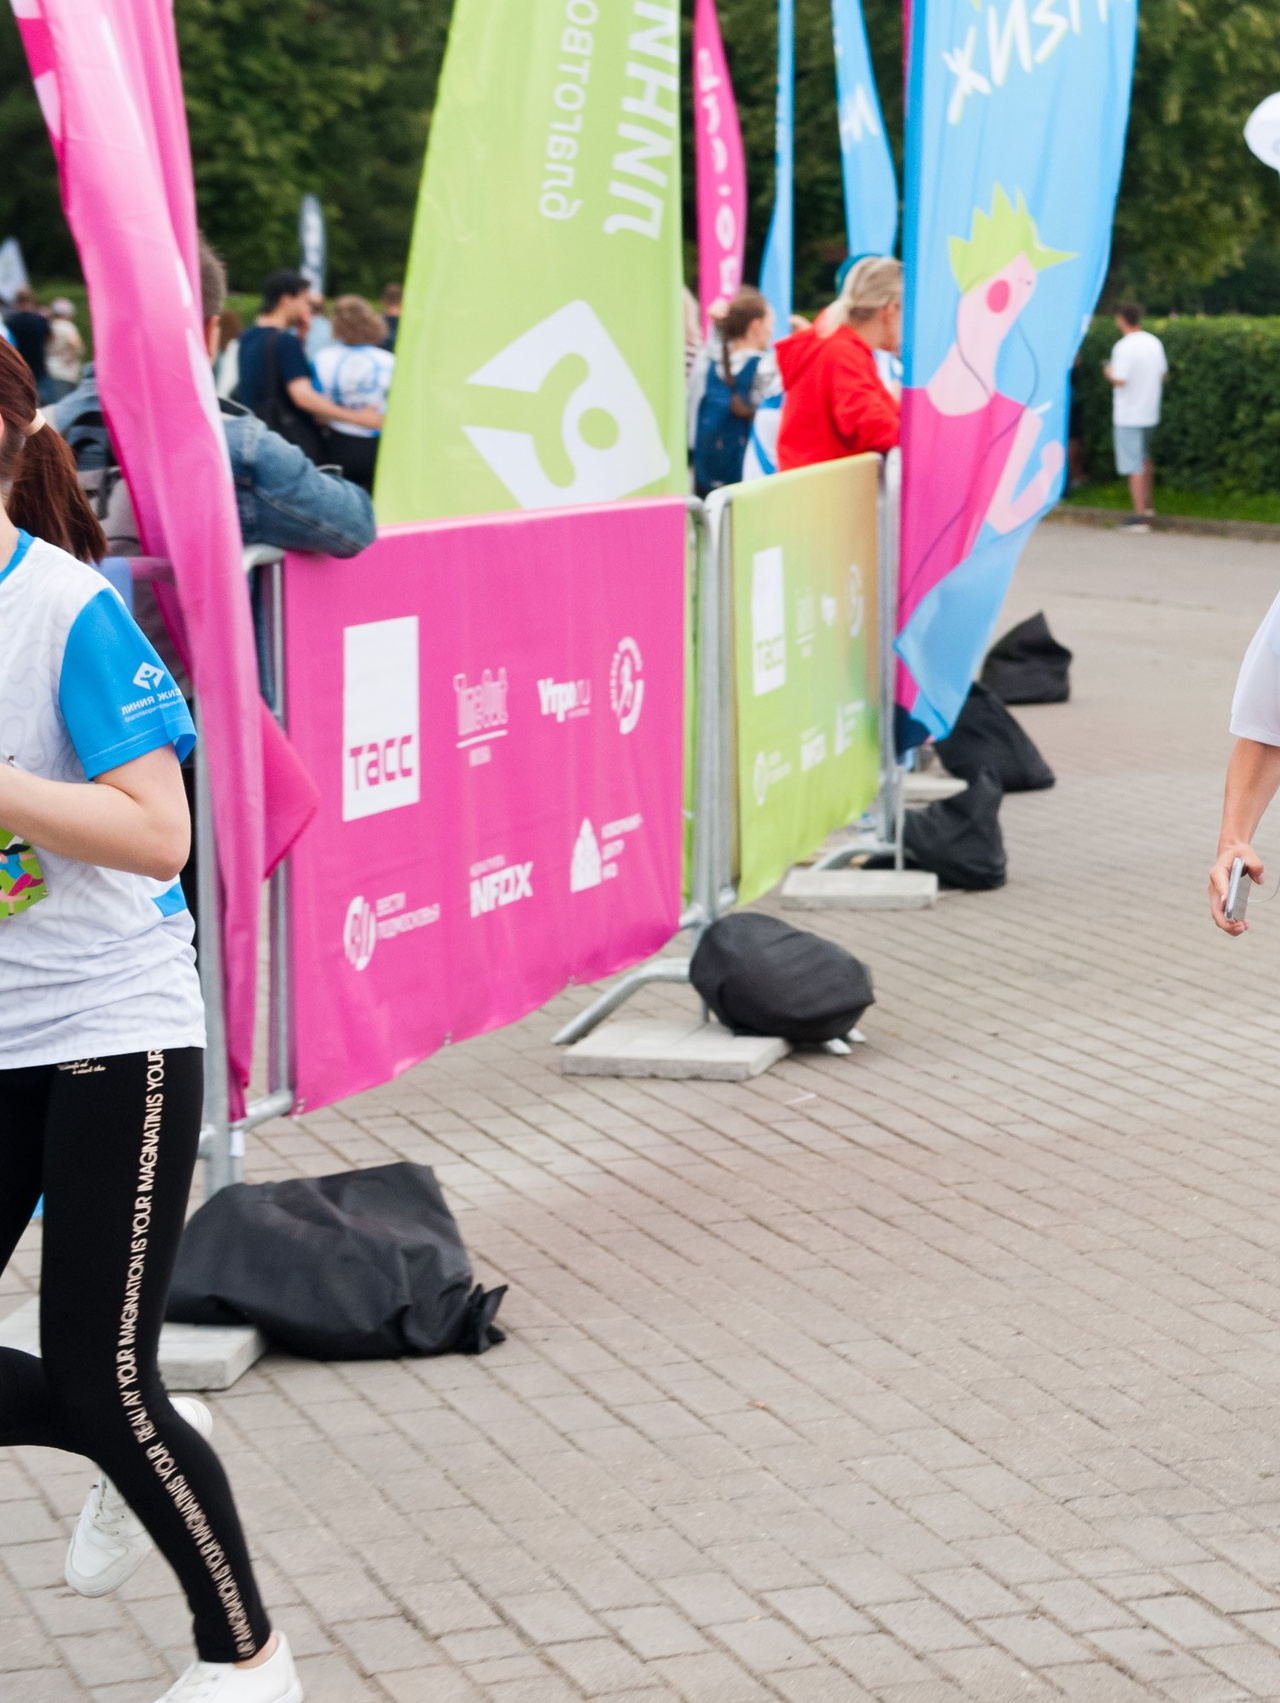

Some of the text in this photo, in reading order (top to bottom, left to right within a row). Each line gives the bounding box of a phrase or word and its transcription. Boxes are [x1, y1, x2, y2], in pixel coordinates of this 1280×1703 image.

[121, 695, 156, 716] ЛИНИЯ
[146, 1048, 165, 1091] YOUR
[132, 1195, 152, 1239] YOUR
[131, 1238, 148, 1253] IS
[117, 1254, 146, 1347] IMAGINATION
[116, 1347, 138, 1389] YOUR
[145, 1441, 179, 1482] YOUR
